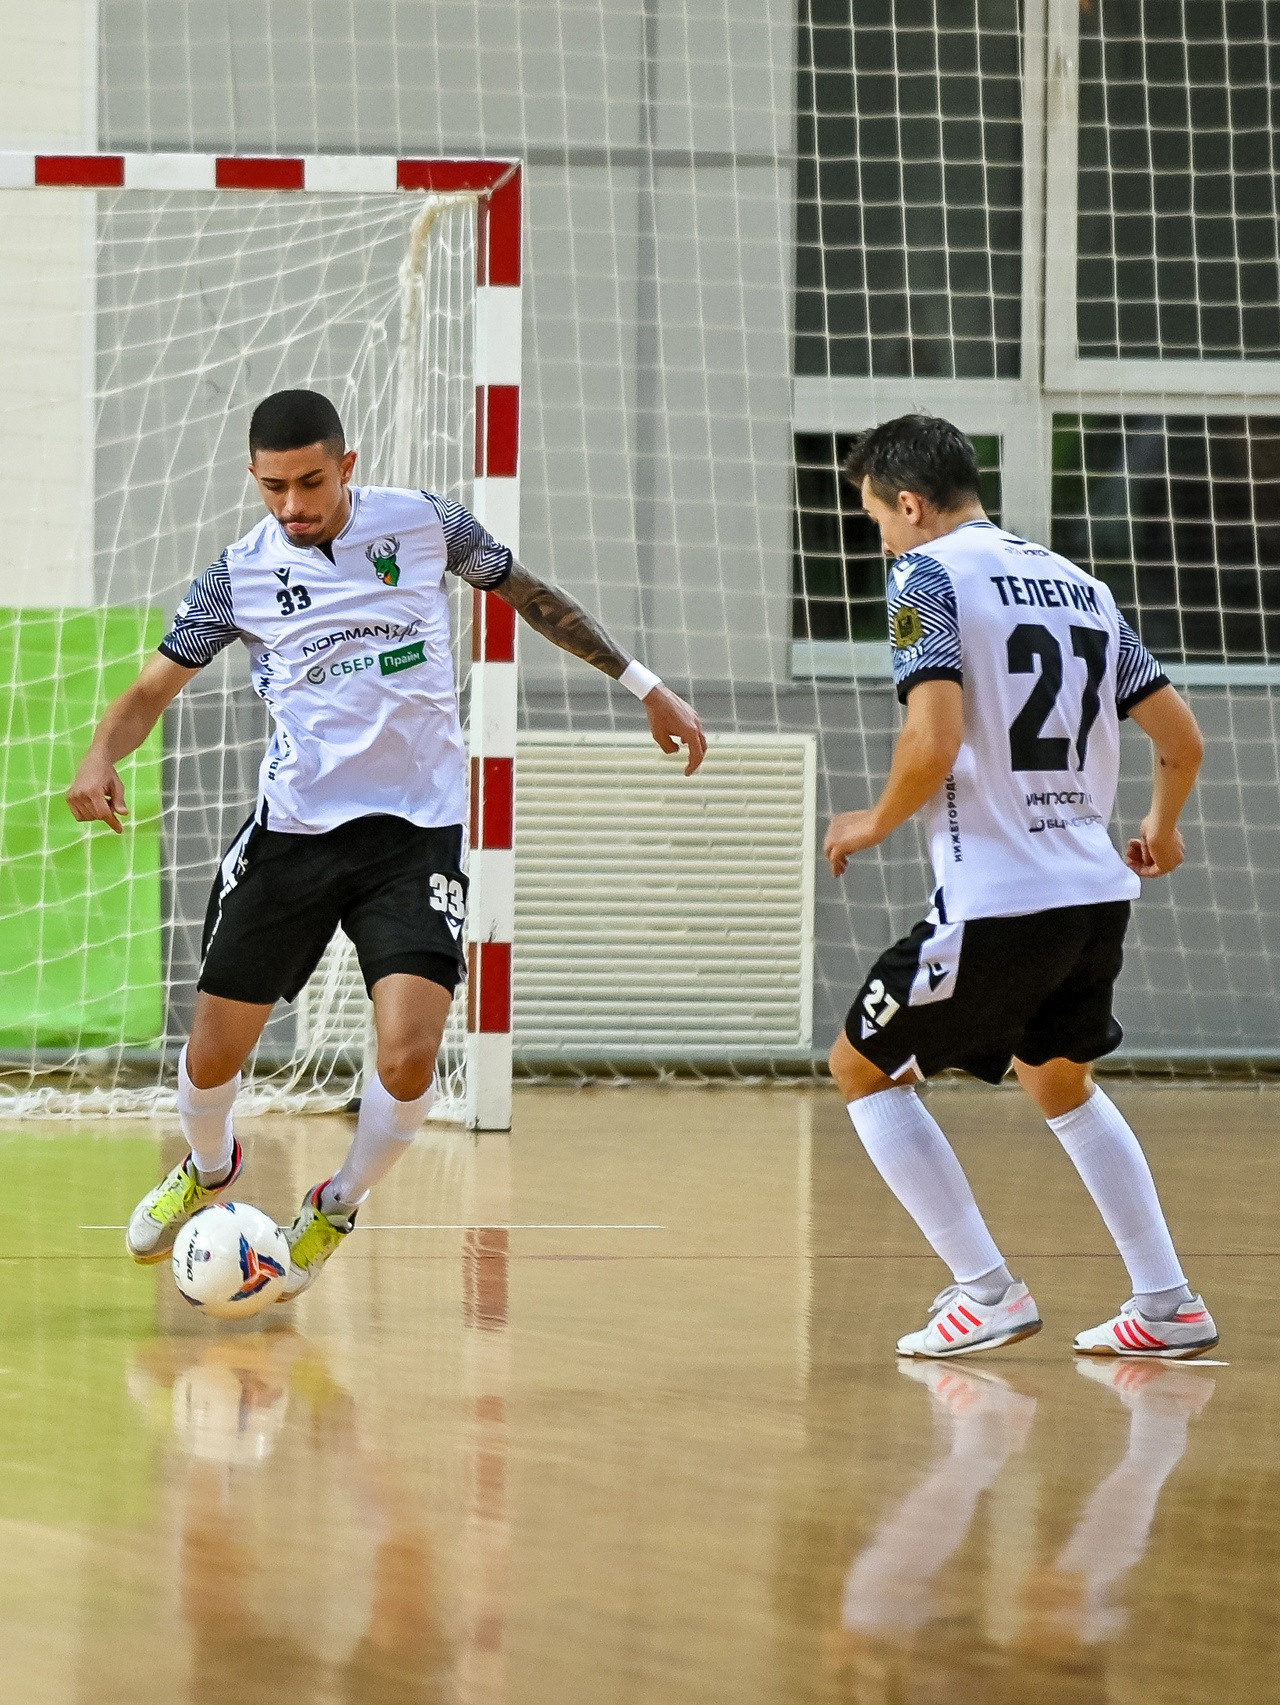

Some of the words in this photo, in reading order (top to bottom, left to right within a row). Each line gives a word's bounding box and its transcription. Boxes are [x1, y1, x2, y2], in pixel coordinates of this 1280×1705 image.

[276, 585, 312, 616] 33
[990, 575, 1101, 616] ТЕЛЕГИН
[302, 624, 389, 657] NORMAN
[330, 657, 374, 676] СБЕР
[1007, 623, 1110, 772] 27
[945, 773, 963, 863] НИЖЕГОРОДС
[429, 873, 465, 920] 33
[862, 979, 901, 1027] 27
